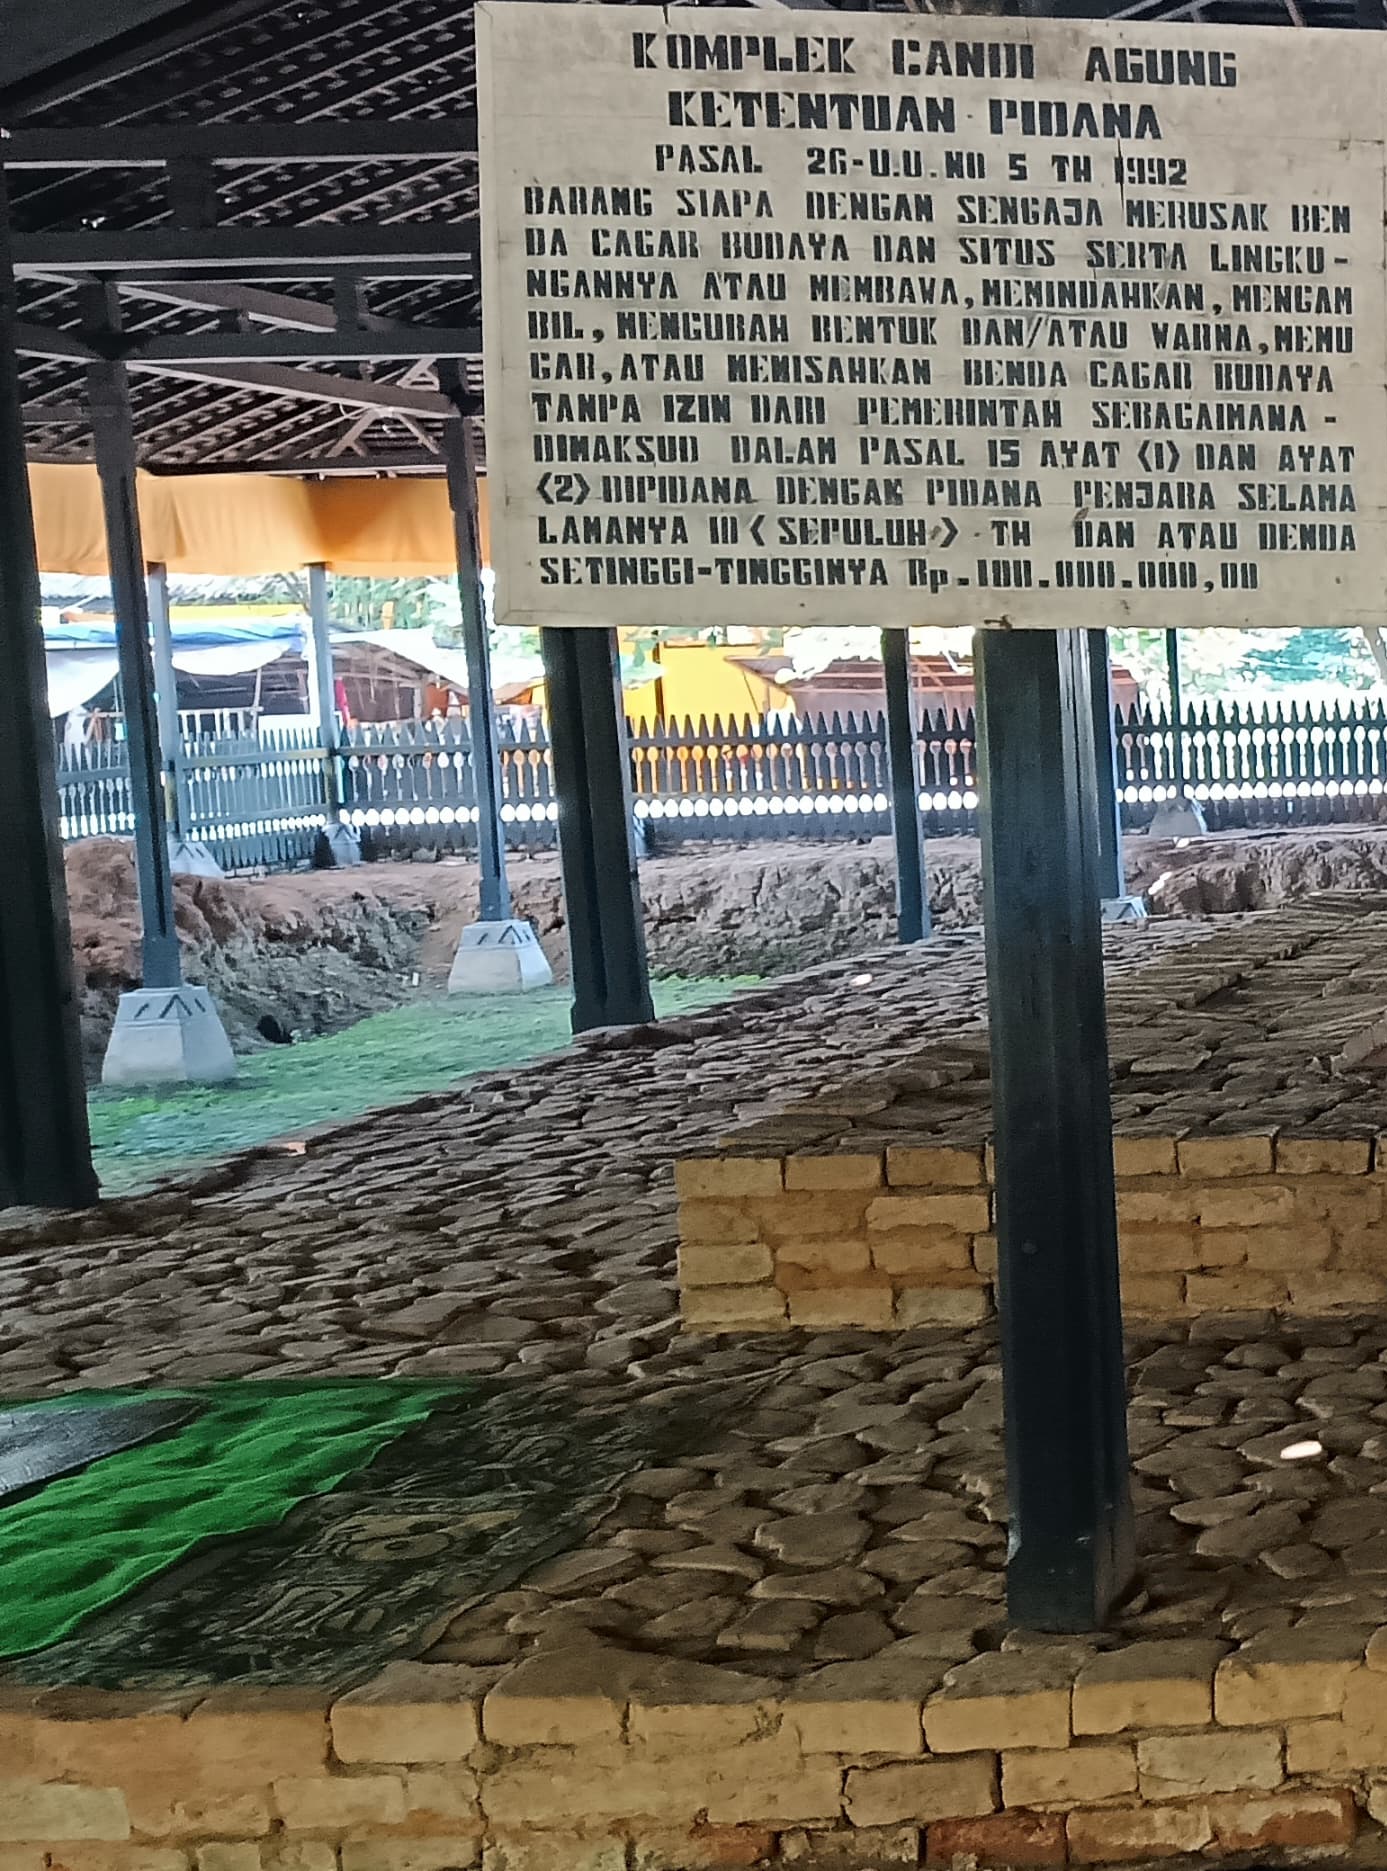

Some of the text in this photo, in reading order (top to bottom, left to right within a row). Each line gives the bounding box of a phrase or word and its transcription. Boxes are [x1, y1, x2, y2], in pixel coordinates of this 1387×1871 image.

[631, 31, 1237, 88] KOMPLEK CANDI AGUNG
[668, 90, 1162, 140] KETENTUAN PIDANA
[655, 144, 763, 175] PASAL
[1008, 153, 1028, 181] 5
[1051, 154, 1092, 183] TH
[1115, 157, 1187, 186] 1992
[523, 186, 1351, 234] BARANG SIAPA DENGAN SENGAJA MERUSAK BEN
[524, 227, 568, 257] DA
[591, 228, 699, 259] CAGAR
[721, 231, 850, 262] BUDAYA
[873, 234, 936, 264] DAN
[957, 236, 1056, 267] SITUS
[1086, 239, 1187, 271] SERTA
[526, 269, 679, 300] NGANNYA
[703, 271, 787, 301] ATAU
[616, 311, 789, 343] MENGUBAH
[811, 314, 938, 346] BENTUK
[727, 354, 931, 385] MEMISAHKAN
[963, 358, 1068, 388] BENDA
[1089, 360, 1192, 390] CAGAR
[1214, 362, 1334, 393] BUDAYA
[531, 391, 642, 423] TANPA
[663, 393, 731, 424] IZIN
[750, 394, 826, 425] DARI
[858, 396, 1062, 428] PEMERINTAH
[533, 433, 699, 463] DIMAKSUD
[730, 435, 837, 465] DALAM
[859, 436, 965, 466] PASAL
[987, 439, 1020, 468] 15
[1040, 439, 1120, 469] AYAT
[1195, 443, 1256, 471] DAN
[1278, 444, 1355, 473] AYAT
[601, 475, 752, 505] DIPIDANA
[926, 478, 1042, 508] PIDANA
[1073, 480, 1216, 511] PENJARA
[1238, 482, 1357, 513] SELAMA
[537, 515, 689, 545] LAMANYA
[990, 520, 1031, 547] TH
[1074, 520, 1135, 549] DAN
[1157, 521, 1238, 551] ATAU
[1258, 522, 1356, 552] DENDA
[539, 556, 889, 586] SETINGGI-TINGGINYA
